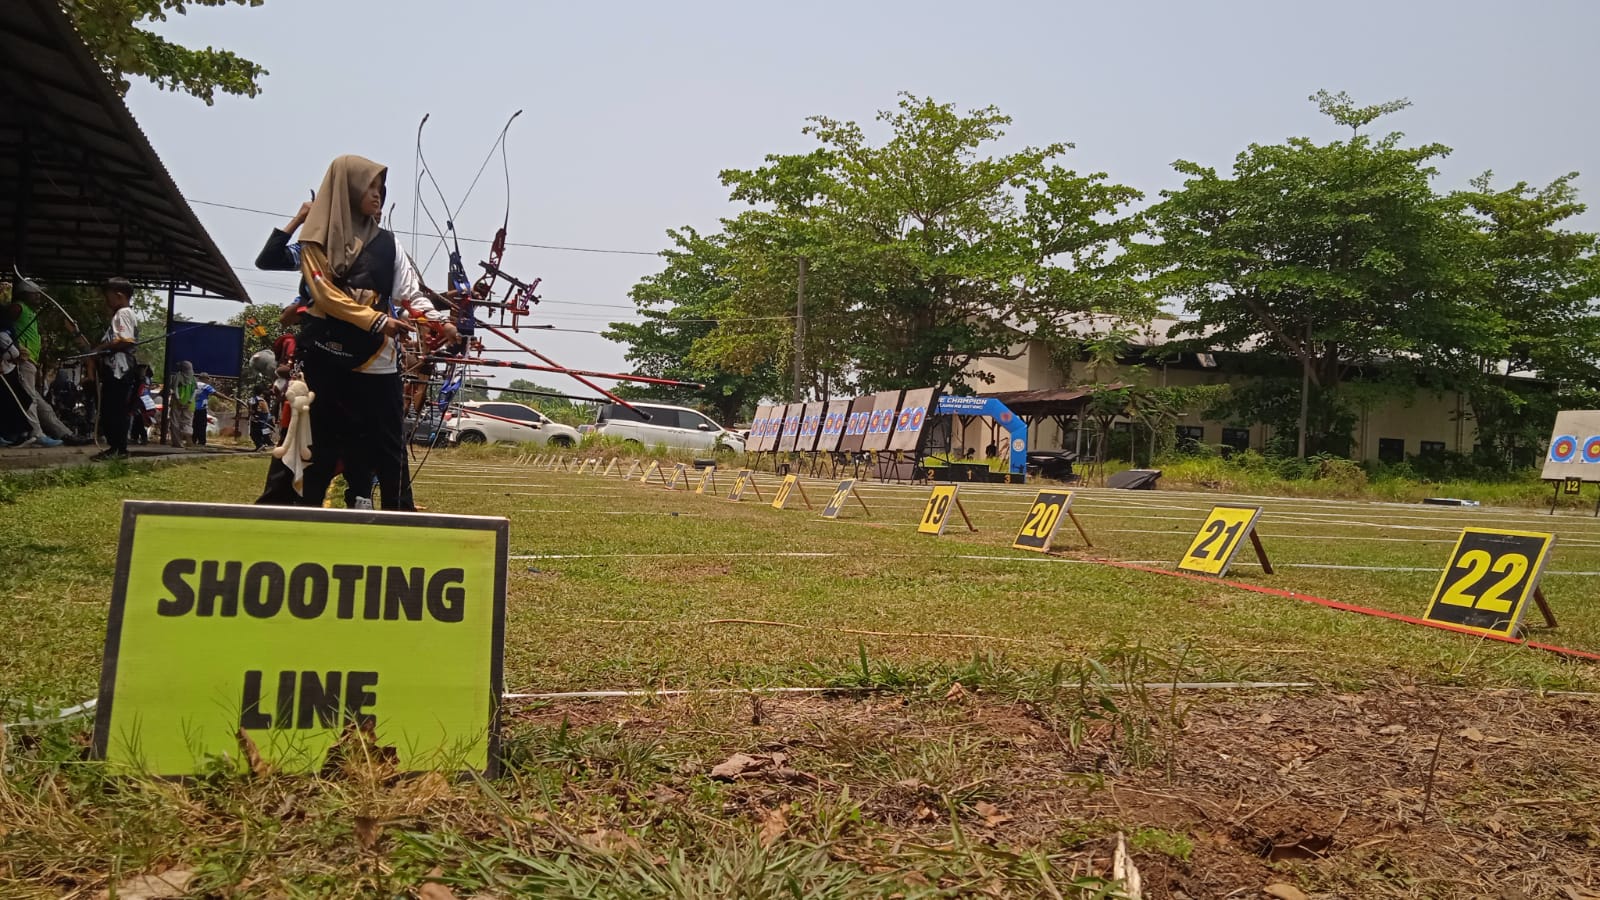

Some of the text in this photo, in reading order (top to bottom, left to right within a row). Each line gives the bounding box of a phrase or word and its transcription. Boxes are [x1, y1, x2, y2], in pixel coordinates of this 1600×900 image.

[947, 397, 987, 405] CHAMPION
[927, 469, 935, 479] 2
[967, 470, 973, 480] 1
[1004, 474, 1011, 483] 3
[1565, 480, 1580, 492] 12
[828, 489, 848, 509] 18
[924, 494, 950, 525] 19
[1023, 502, 1059, 538] 20
[1191, 519, 1243, 561] 21
[157, 558, 465, 623] SHOOTING
[1440, 549, 1529, 613] 22
[240, 670, 378, 729] LINE
